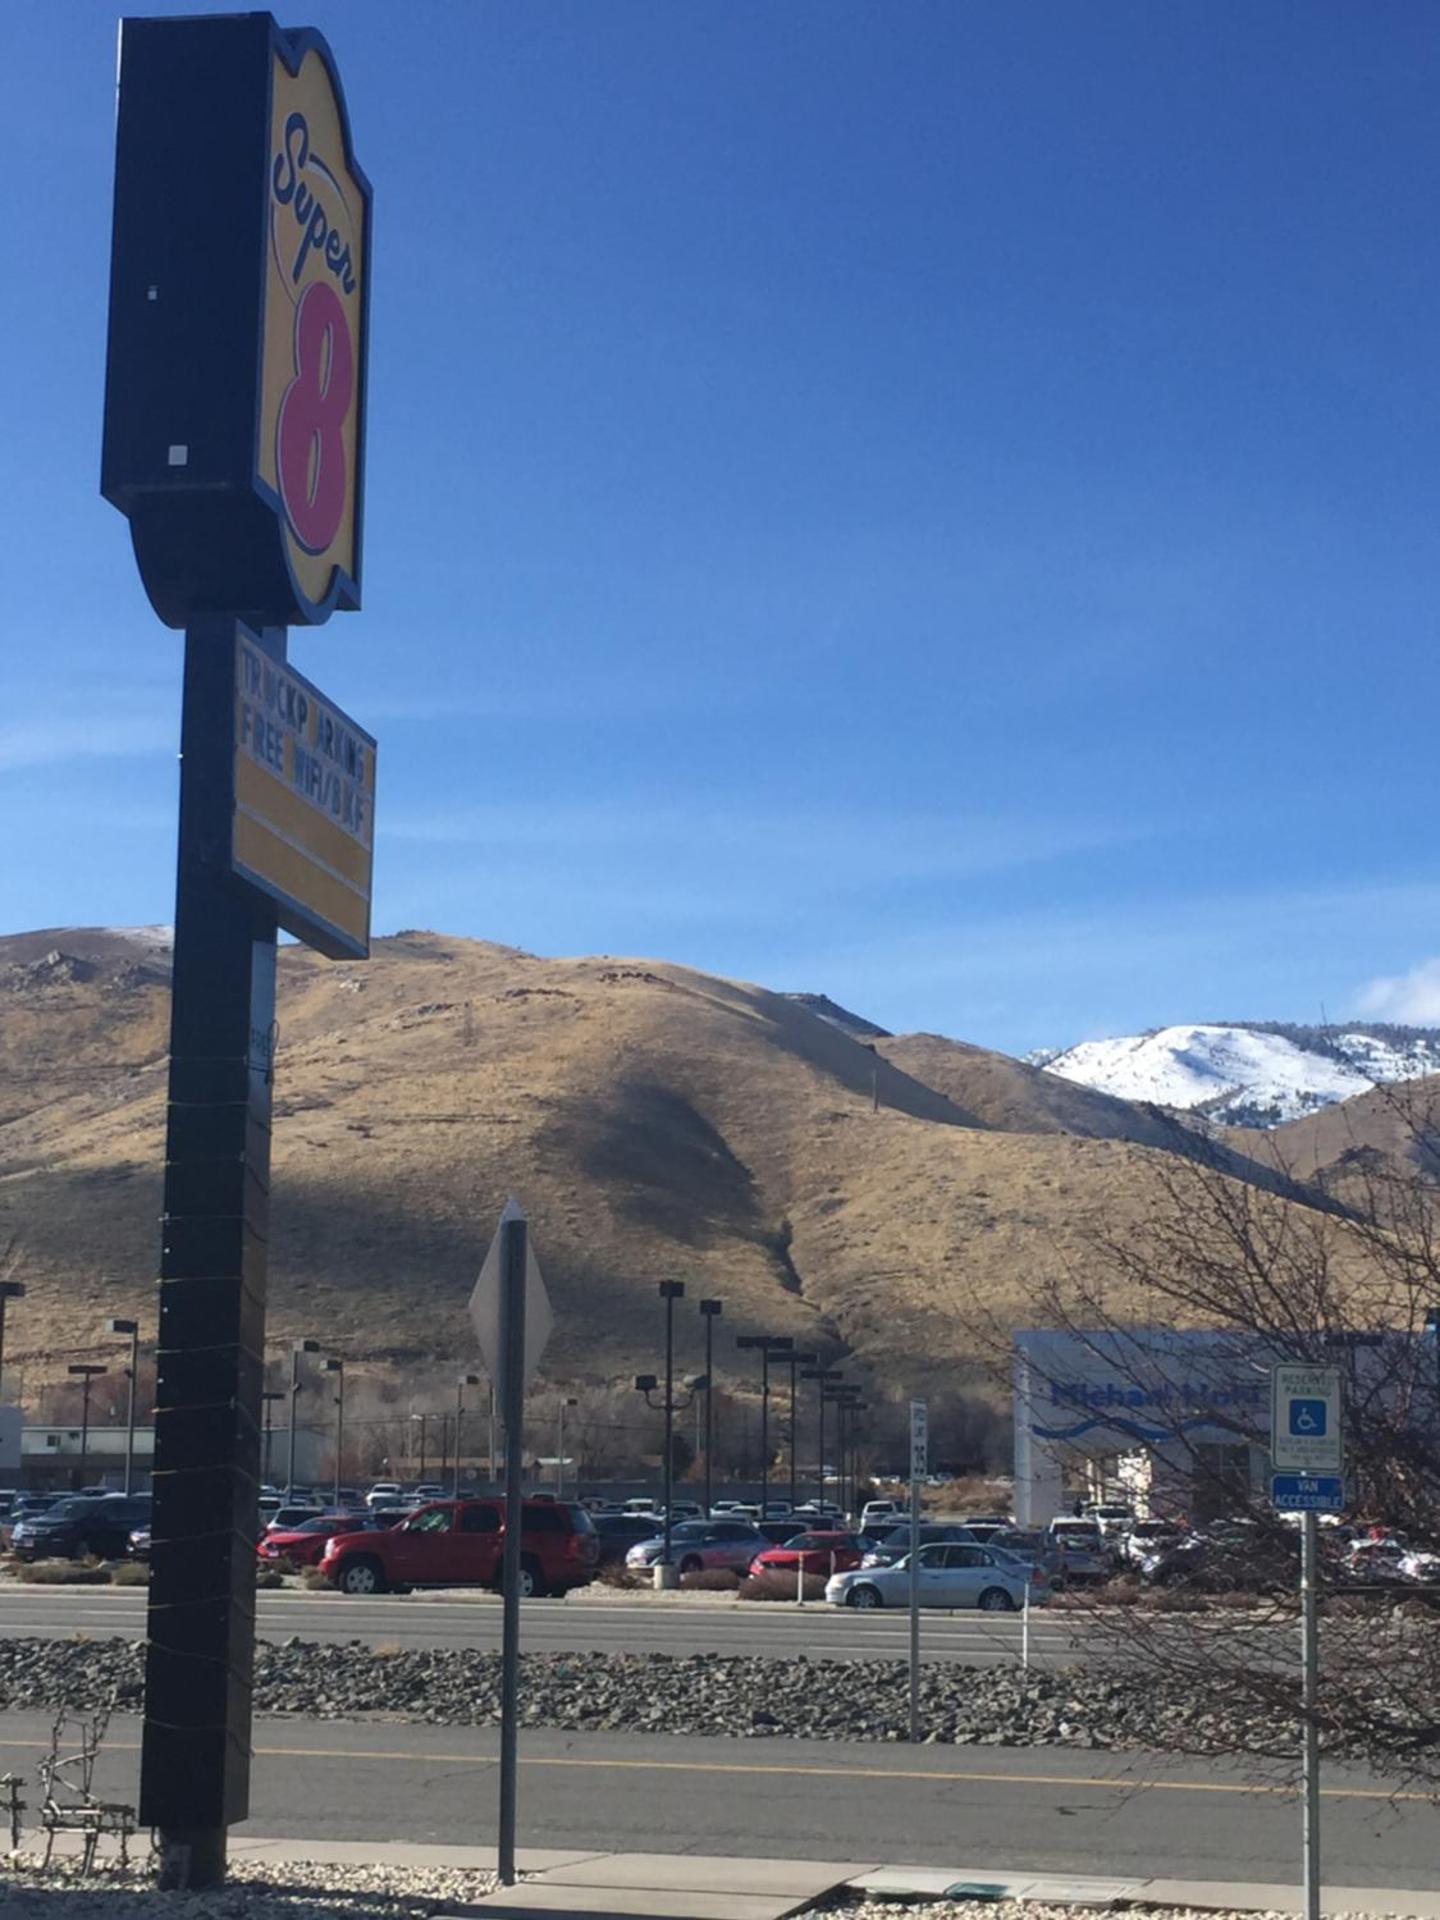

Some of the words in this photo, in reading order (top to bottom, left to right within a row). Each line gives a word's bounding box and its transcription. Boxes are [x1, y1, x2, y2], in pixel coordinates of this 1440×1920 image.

[272, 112, 357, 296] Super
[276, 281, 353, 556] 8
[241, 699, 283, 772] FREE
[1275, 1494, 1341, 1508] ACCESSIBLE
[1297, 1479, 1319, 1493] VAN
